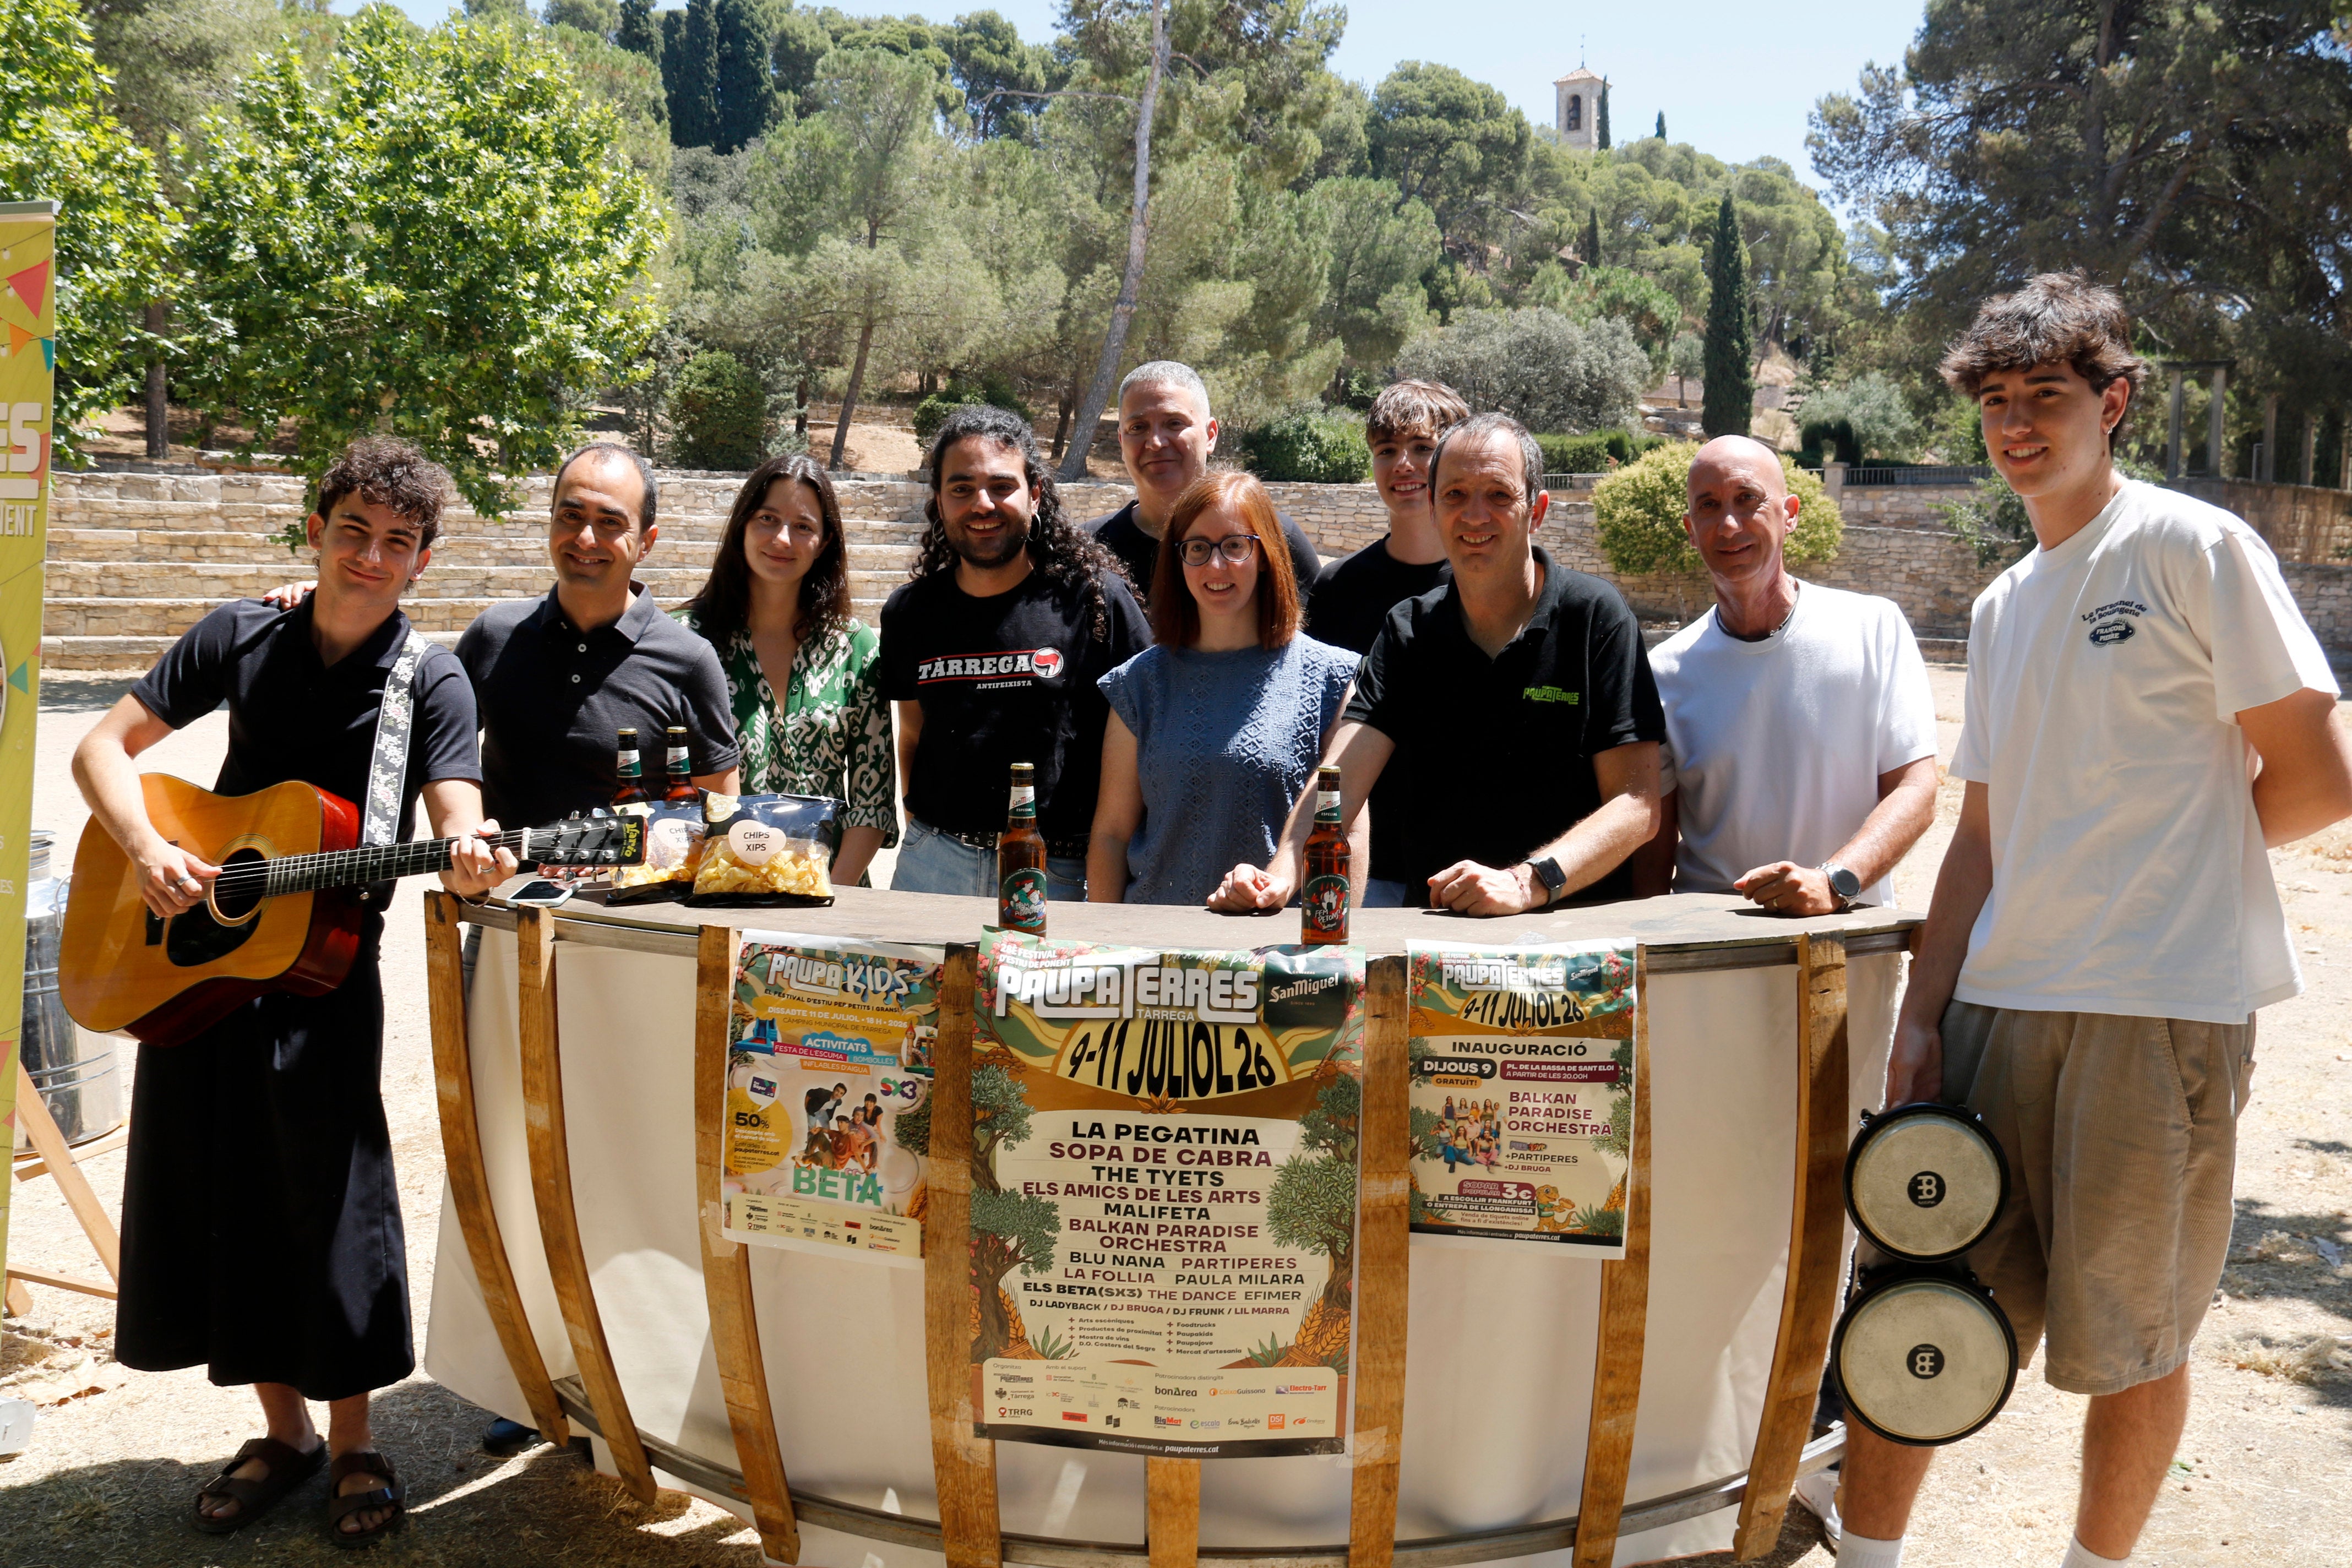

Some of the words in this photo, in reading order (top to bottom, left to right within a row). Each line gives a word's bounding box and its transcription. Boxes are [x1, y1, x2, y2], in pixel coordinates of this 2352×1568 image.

[0, 505, 37, 535] ENT
[2082, 612, 2093, 621] Le
[918, 657, 1032, 679] TÀRREGA
[976, 680, 1032, 689] ANTIFEIXISTA
[1523, 685, 1579, 705] PAUPATERRES
[743, 831, 770, 840] CHIPS
[1315, 909, 1328, 917] FEM
[767, 953, 840, 996] PAUPA
[847, 963, 910, 994] KIDS
[1442, 958, 1564, 991] PAUPATERRES
[1570, 965, 1599, 981] SanMiguel
[995, 953, 1258, 1023] PAUPATERRES
[1268, 972, 1339, 1003] SanMiguel
[774, 990, 805, 1002] FESTIVAL
[768, 1006, 807, 1016] DISSABTE
[831, 1013, 859, 1022] JULIOL
[888, 1020, 907, 1028] 2026
[1136, 1007, 1195, 1022] TÀRREGA
[1464, 992, 1499, 1025] 9-11
[1499, 992, 1561, 1027] JULIOL
[1561, 994, 1585, 1022] 26
[783, 1017, 813, 1026] CÀMPING
[815, 1020, 849, 1030] MUNICIPAL
[862, 1025, 891, 1035] TÀRREGA
[805, 1038, 867, 1053] ACTIVITATS
[1452, 1041, 1587, 1057] INAUGURACIÓ
[809, 1049, 843, 1060] L'ESCUMA
[853, 1056, 894, 1064] BOMBOLLES
[1069, 1020, 1126, 1090] 9-11
[1126, 1020, 1233, 1098] JULIOL
[1234, 1027, 1276, 1091] 26
[803, 1060, 840, 1070] INFLABLES
[841, 1065, 868, 1074] D'AIGUA
[1424, 1061, 1478, 1074] DIJOUS
[1482, 1063, 1491, 1074] 9
[1435, 1077, 1477, 1086] GRATUÏT!
[1509, 1091, 1577, 1104] BALKAN
[735, 1112, 769, 1128] 50%
[1508, 1107, 1592, 1119] PARADISE
[1072, 1121, 1106, 1139] LA
[1114, 1124, 1260, 1145] PEGATINA
[1507, 1120, 1612, 1135] ORCHESTRA
[1049, 1142, 1124, 1162] SOPA
[1133, 1147, 1167, 1164] DE
[1177, 1149, 1272, 1167] CABRA
[1506, 1153, 1578, 1163] +PARTIPERES
[1091, 1166, 1139, 1184] THE
[1146, 1168, 1224, 1187] TYETS
[793, 1164, 881, 1206] BETA
[1023, 1182, 1058, 1196] ELS
[1064, 1184, 1129, 1200] AMICS
[1135, 1189, 1160, 1202] DE
[1166, 1190, 1202, 1203] LES
[1207, 1190, 1261, 1204] ARTS
[1463, 1182, 1499, 1190] SOPAR
[1502, 1183, 1532, 1200] 3€
[1104, 1203, 1210, 1221] MALIFETA
[1069, 1218, 1150, 1238] BALKAN
[1157, 1223, 1259, 1238] PARADISE
[1099, 1237, 1227, 1253] ORCHESTRA
[1514, 1233, 1560, 1241] paupaterres.cat
[1070, 1251, 1106, 1265] BLU
[1112, 1256, 1166, 1268] NANA
[1182, 1257, 1297, 1269] PARTIPERES
[1064, 1267, 1086, 1279] LA
[1092, 1270, 1155, 1283] FOLLIA
[1175, 1274, 1232, 1285] PAULA
[1239, 1274, 1305, 1285] MILARA
[1023, 1282, 1052, 1293] ELS
[1057, 1284, 1142, 1299] BETA(SX3)
[1147, 1289, 1177, 1300] THE
[1183, 1291, 1237, 1301] DANCE
[1245, 1291, 1301, 1300] EFIMER
[1045, 1300, 1101, 1311] LADYBACK
[1110, 1303, 1124, 1311] DJ
[1126, 1304, 1163, 1314] BRUGA
[1251, 1307, 1290, 1315] MARRA
[1165, 1445, 1219, 1453] paupaterres.cat
